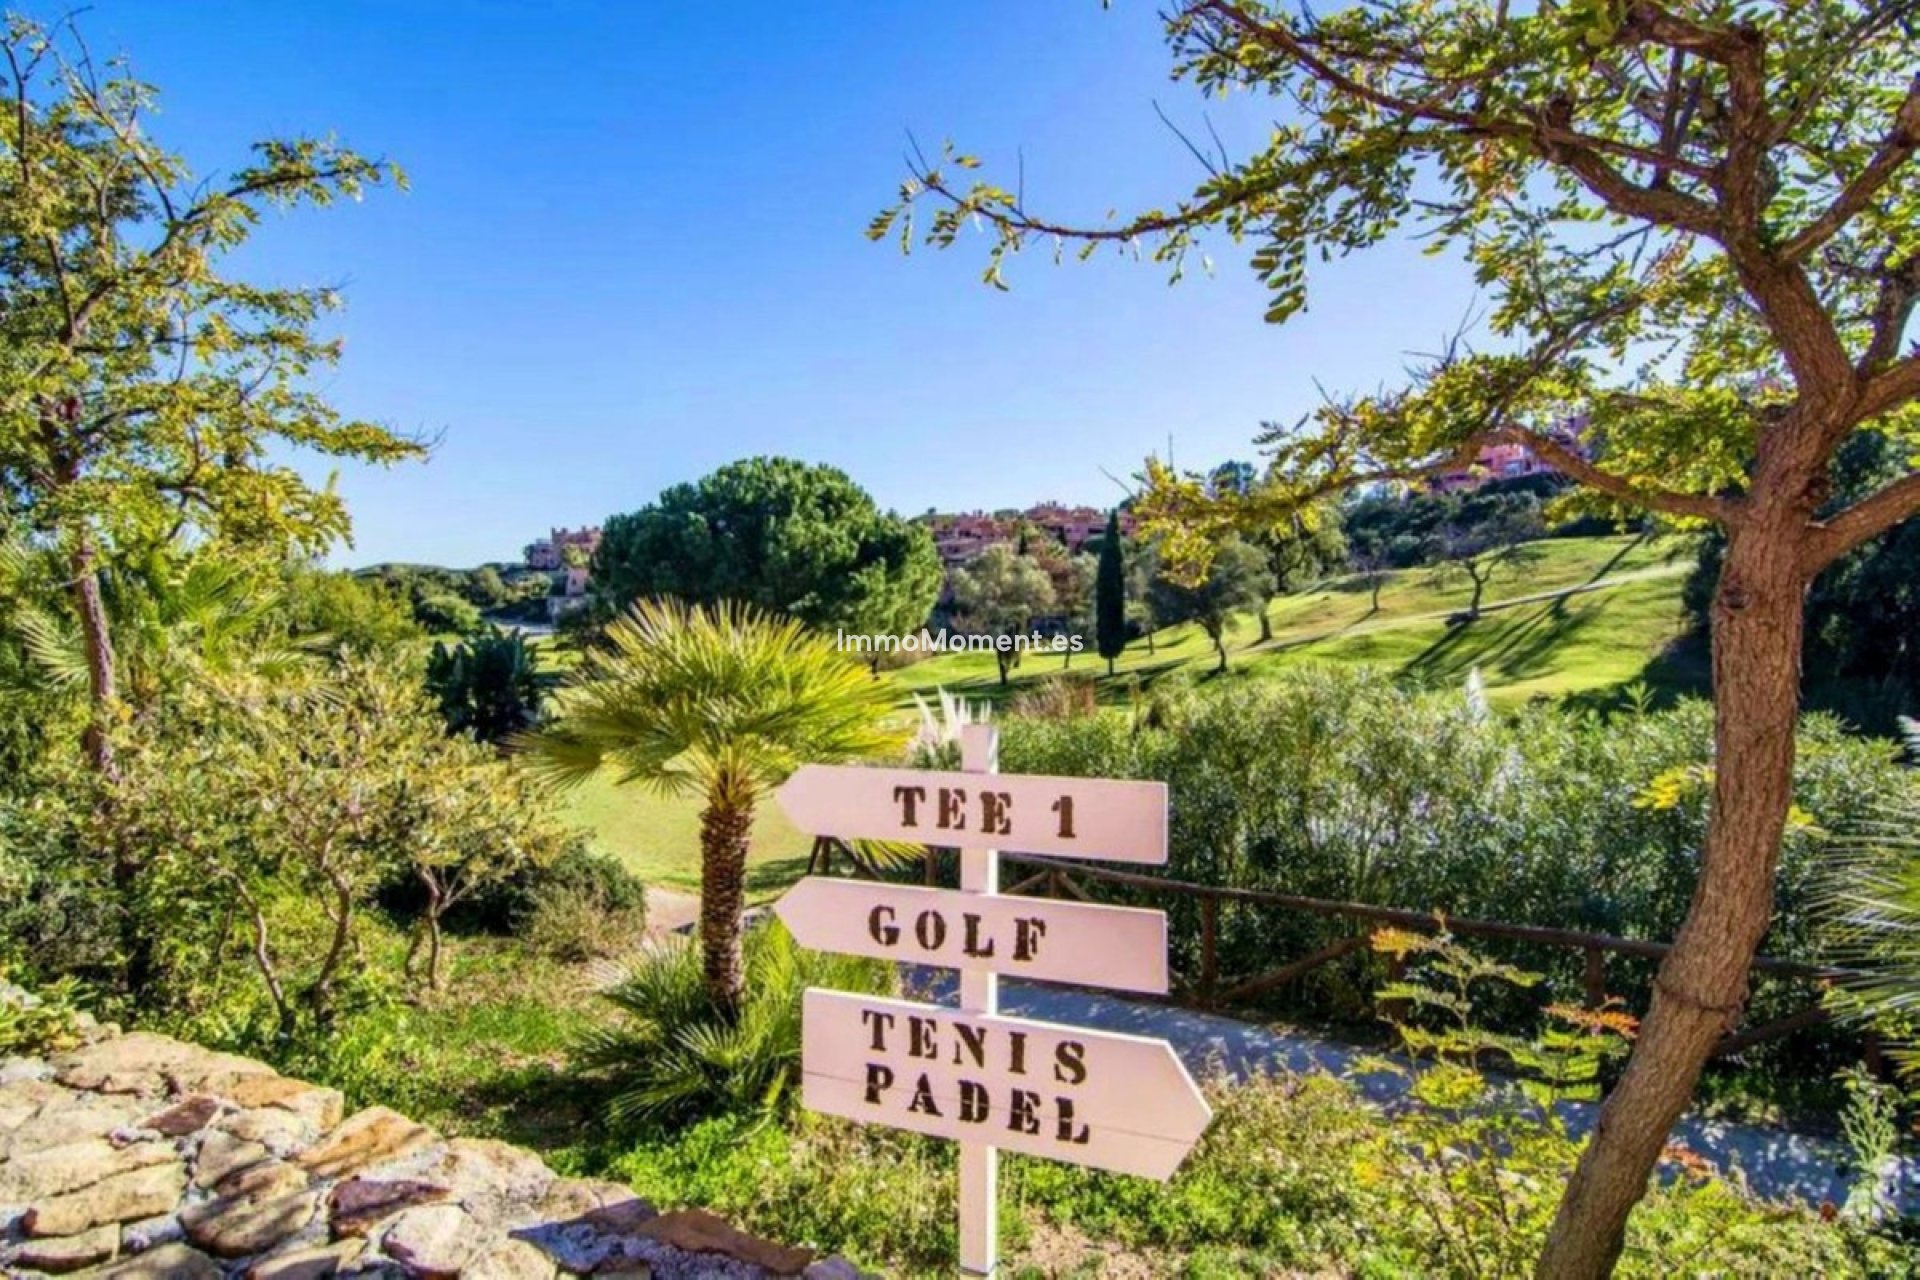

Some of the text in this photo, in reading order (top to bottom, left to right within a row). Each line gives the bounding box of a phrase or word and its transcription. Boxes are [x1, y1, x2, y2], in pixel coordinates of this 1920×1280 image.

[893, 785, 1077, 839] TEE 1
[867, 904, 1047, 962] GOLF
[861, 1009, 1088, 1086] TENIS
[863, 1062, 1091, 1145] PADEL
